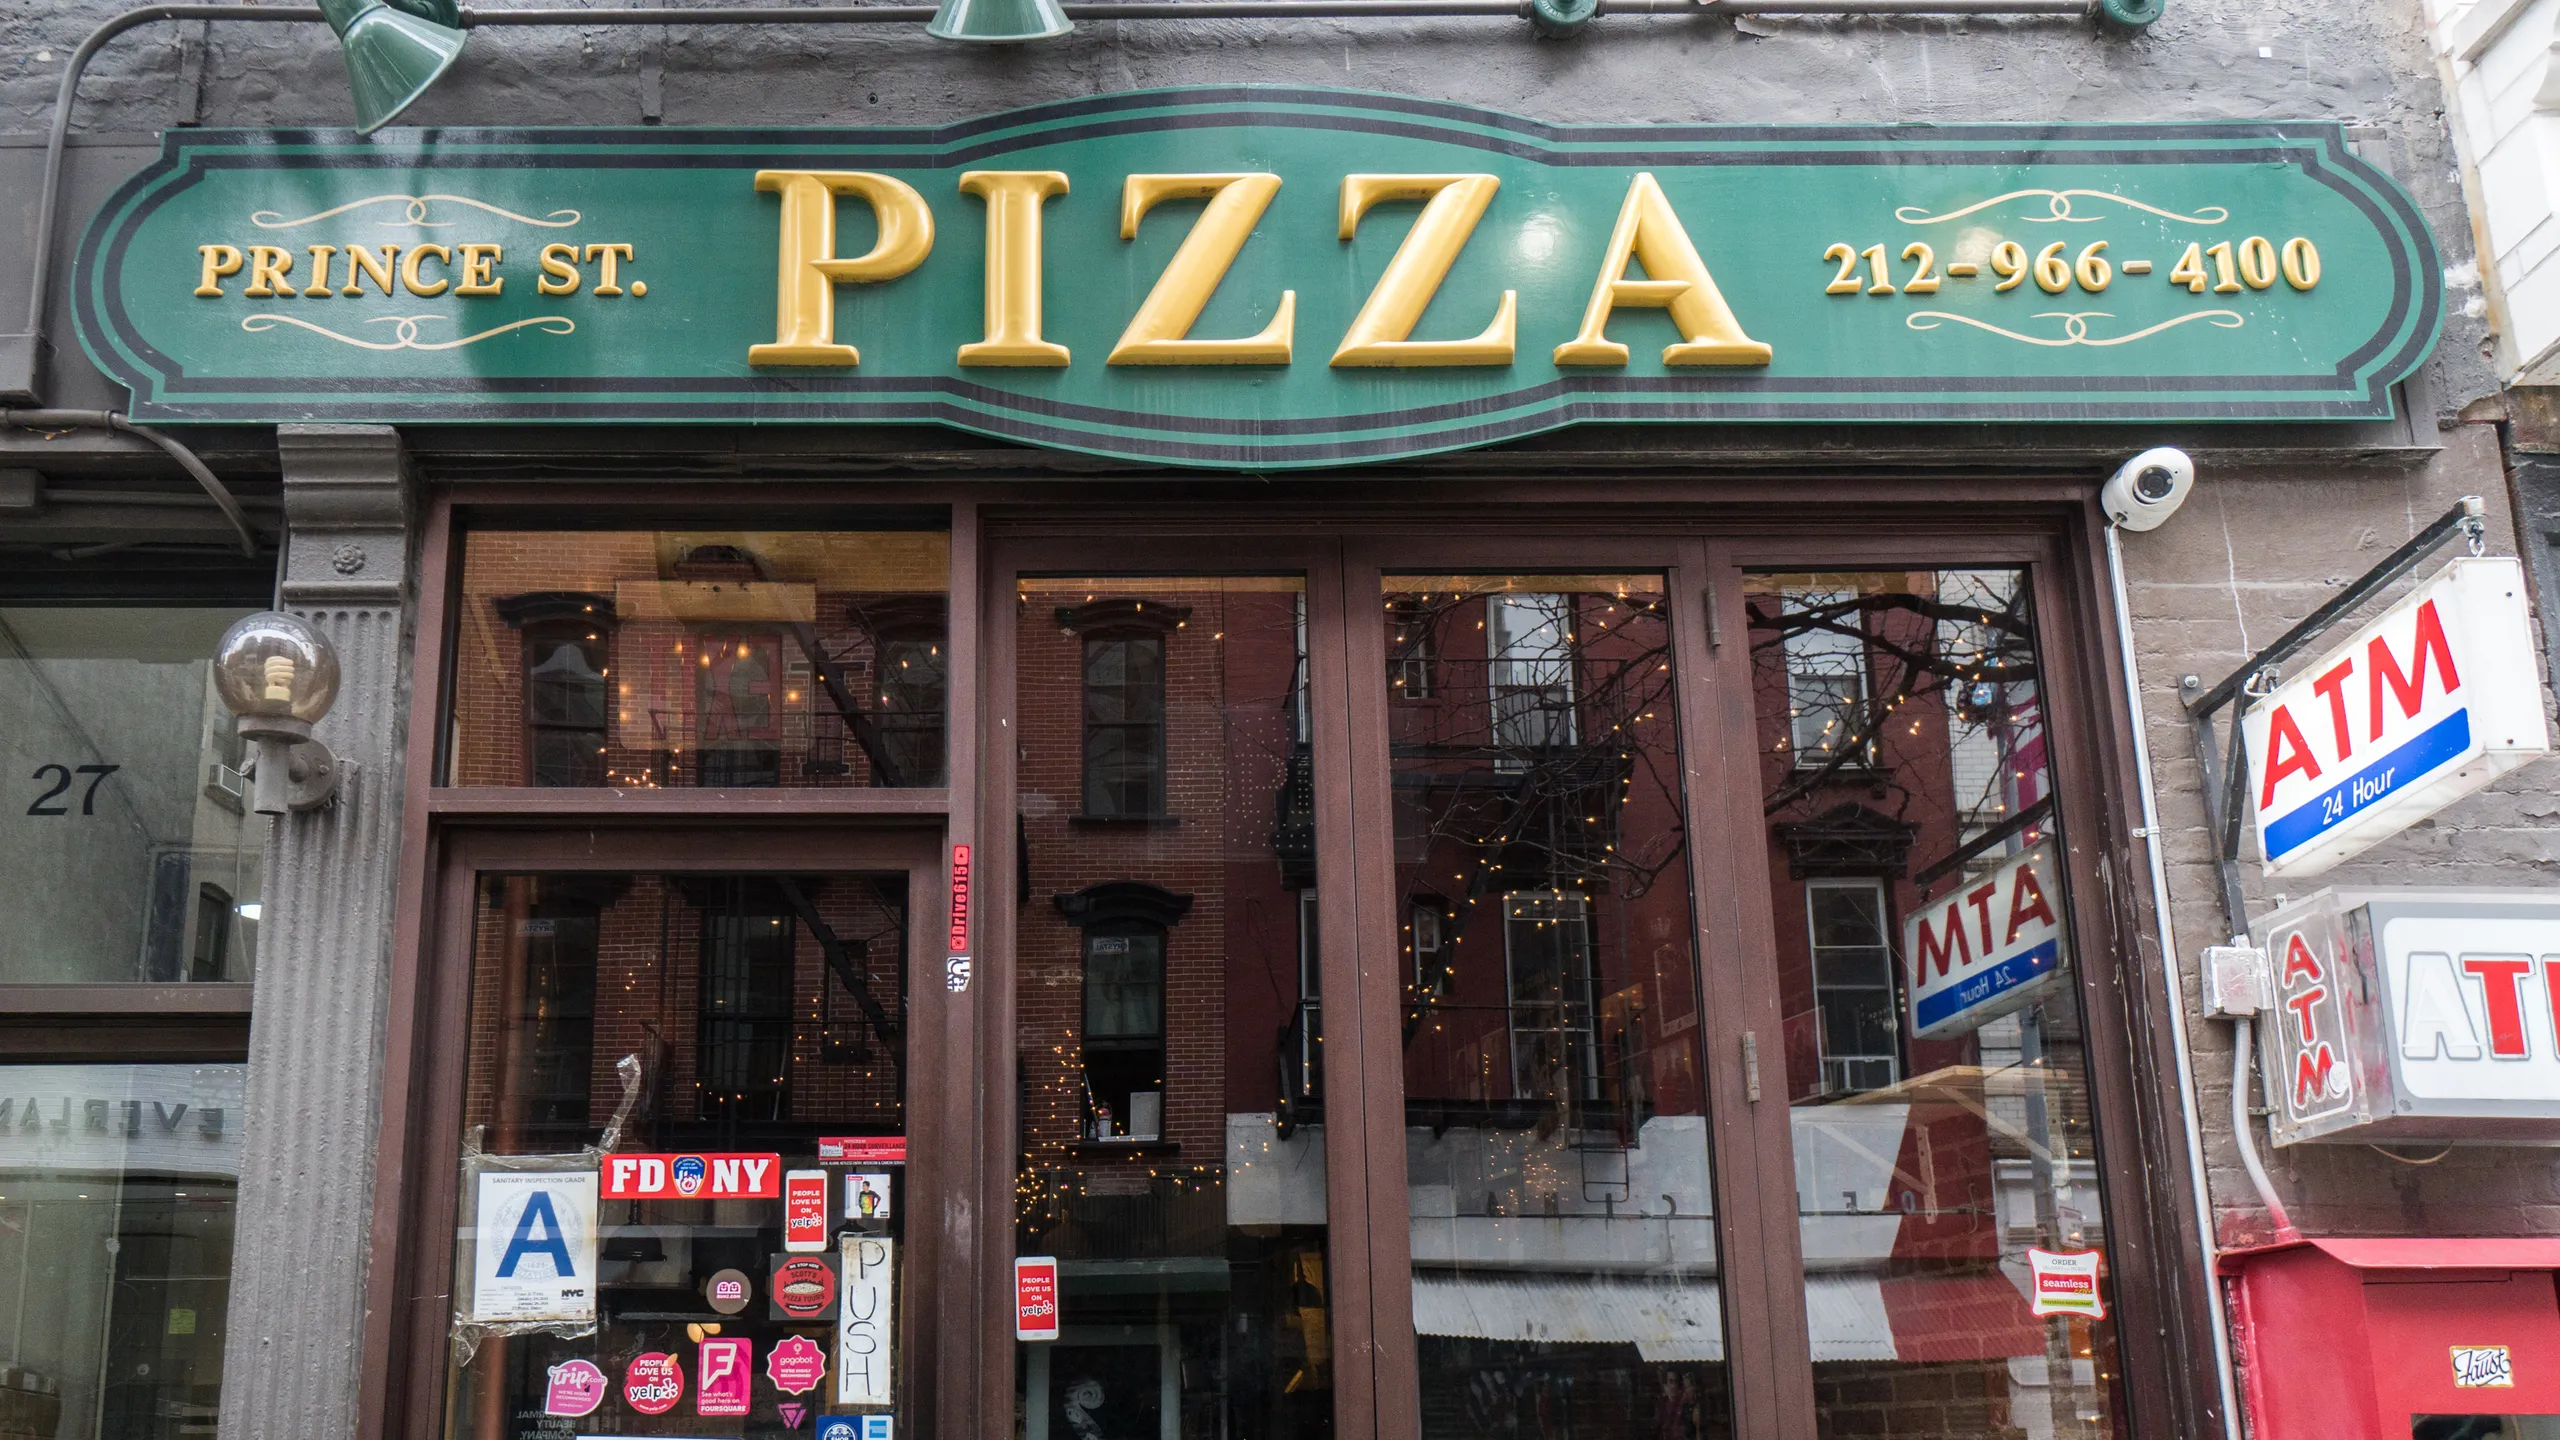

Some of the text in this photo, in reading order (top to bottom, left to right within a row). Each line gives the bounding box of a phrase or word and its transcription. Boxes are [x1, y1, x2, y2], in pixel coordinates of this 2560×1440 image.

[194, 243, 649, 298] PRINCE ST.
[747, 169, 1775, 368] PIZZA
[2260, 598, 2461, 811] ATM
[26, 764, 121, 816] 27
[2322, 766, 2396, 825] 24 Hour
[952, 866, 968, 935] Drive615
[2282, 931, 2342, 1110] ATM
[2403, 951, 2560, 1062] AT
[495, 1191, 576, 1278] A
[791, 1217, 813, 1229] yelp
[561, 1289, 584, 1297] NYC
[783, 1293, 824, 1302] PIZZA TOURS
[2043, 1279, 2089, 1288] seamless
[1021, 1304, 1043, 1317] yelp
[780, 1356, 813, 1365] gogobot
[630, 1384, 663, 1402] yelp
